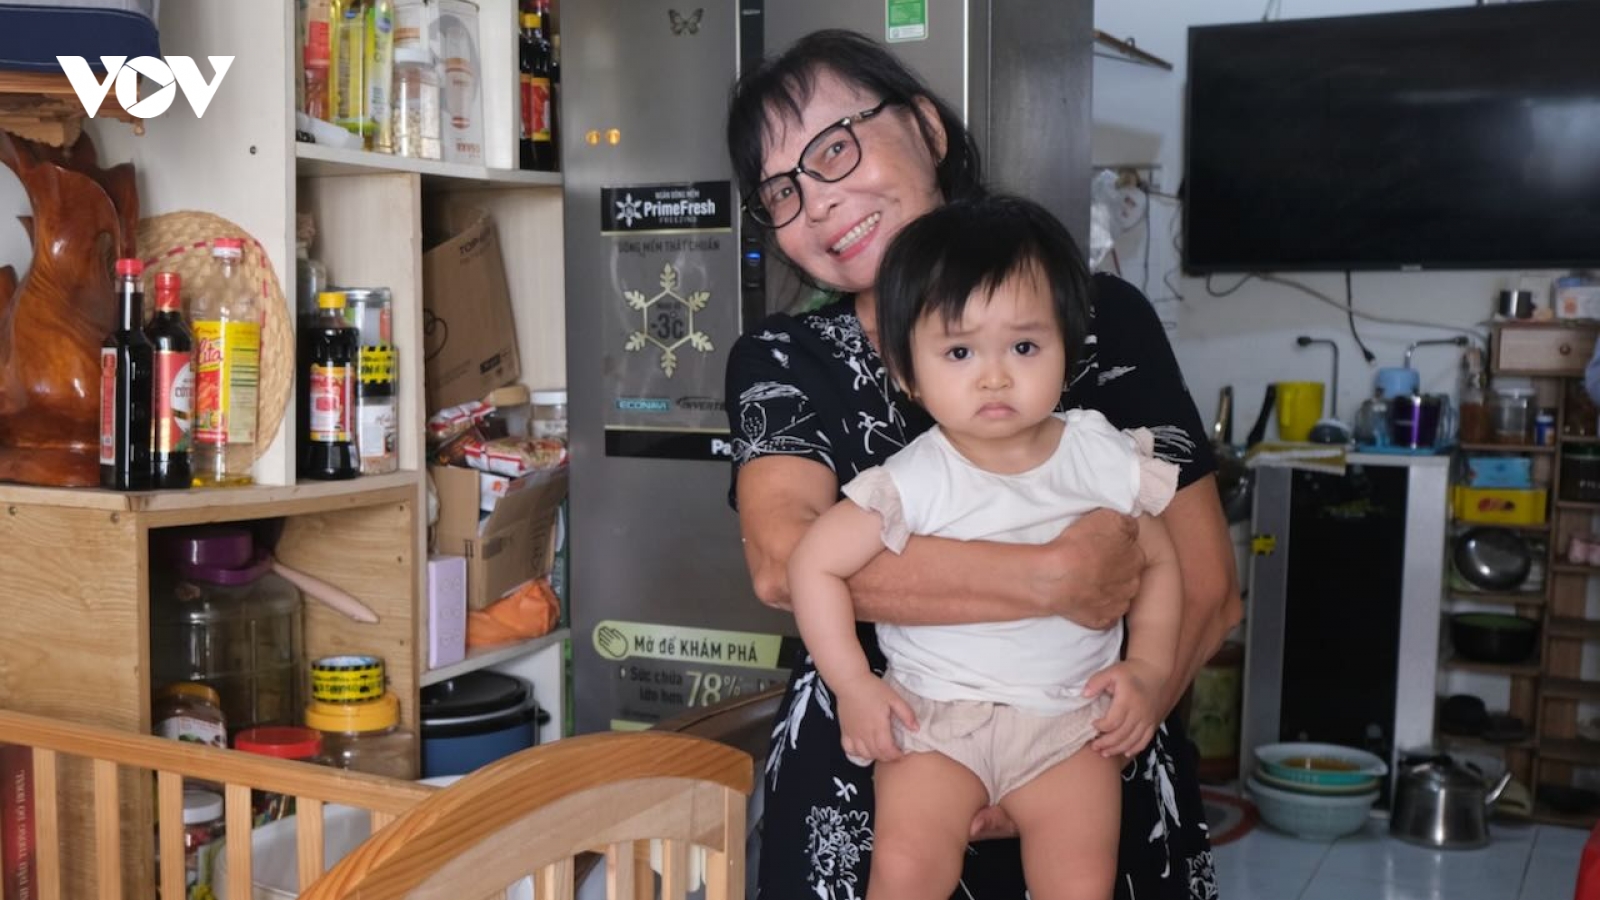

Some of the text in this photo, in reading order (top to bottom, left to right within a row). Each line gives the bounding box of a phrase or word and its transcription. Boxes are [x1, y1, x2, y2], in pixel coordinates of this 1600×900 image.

[643, 199, 716, 217] PrimeFresh
[619, 400, 667, 410] ECONAVI
[634, 635, 758, 662] Mở để KHÁM PHÁ
